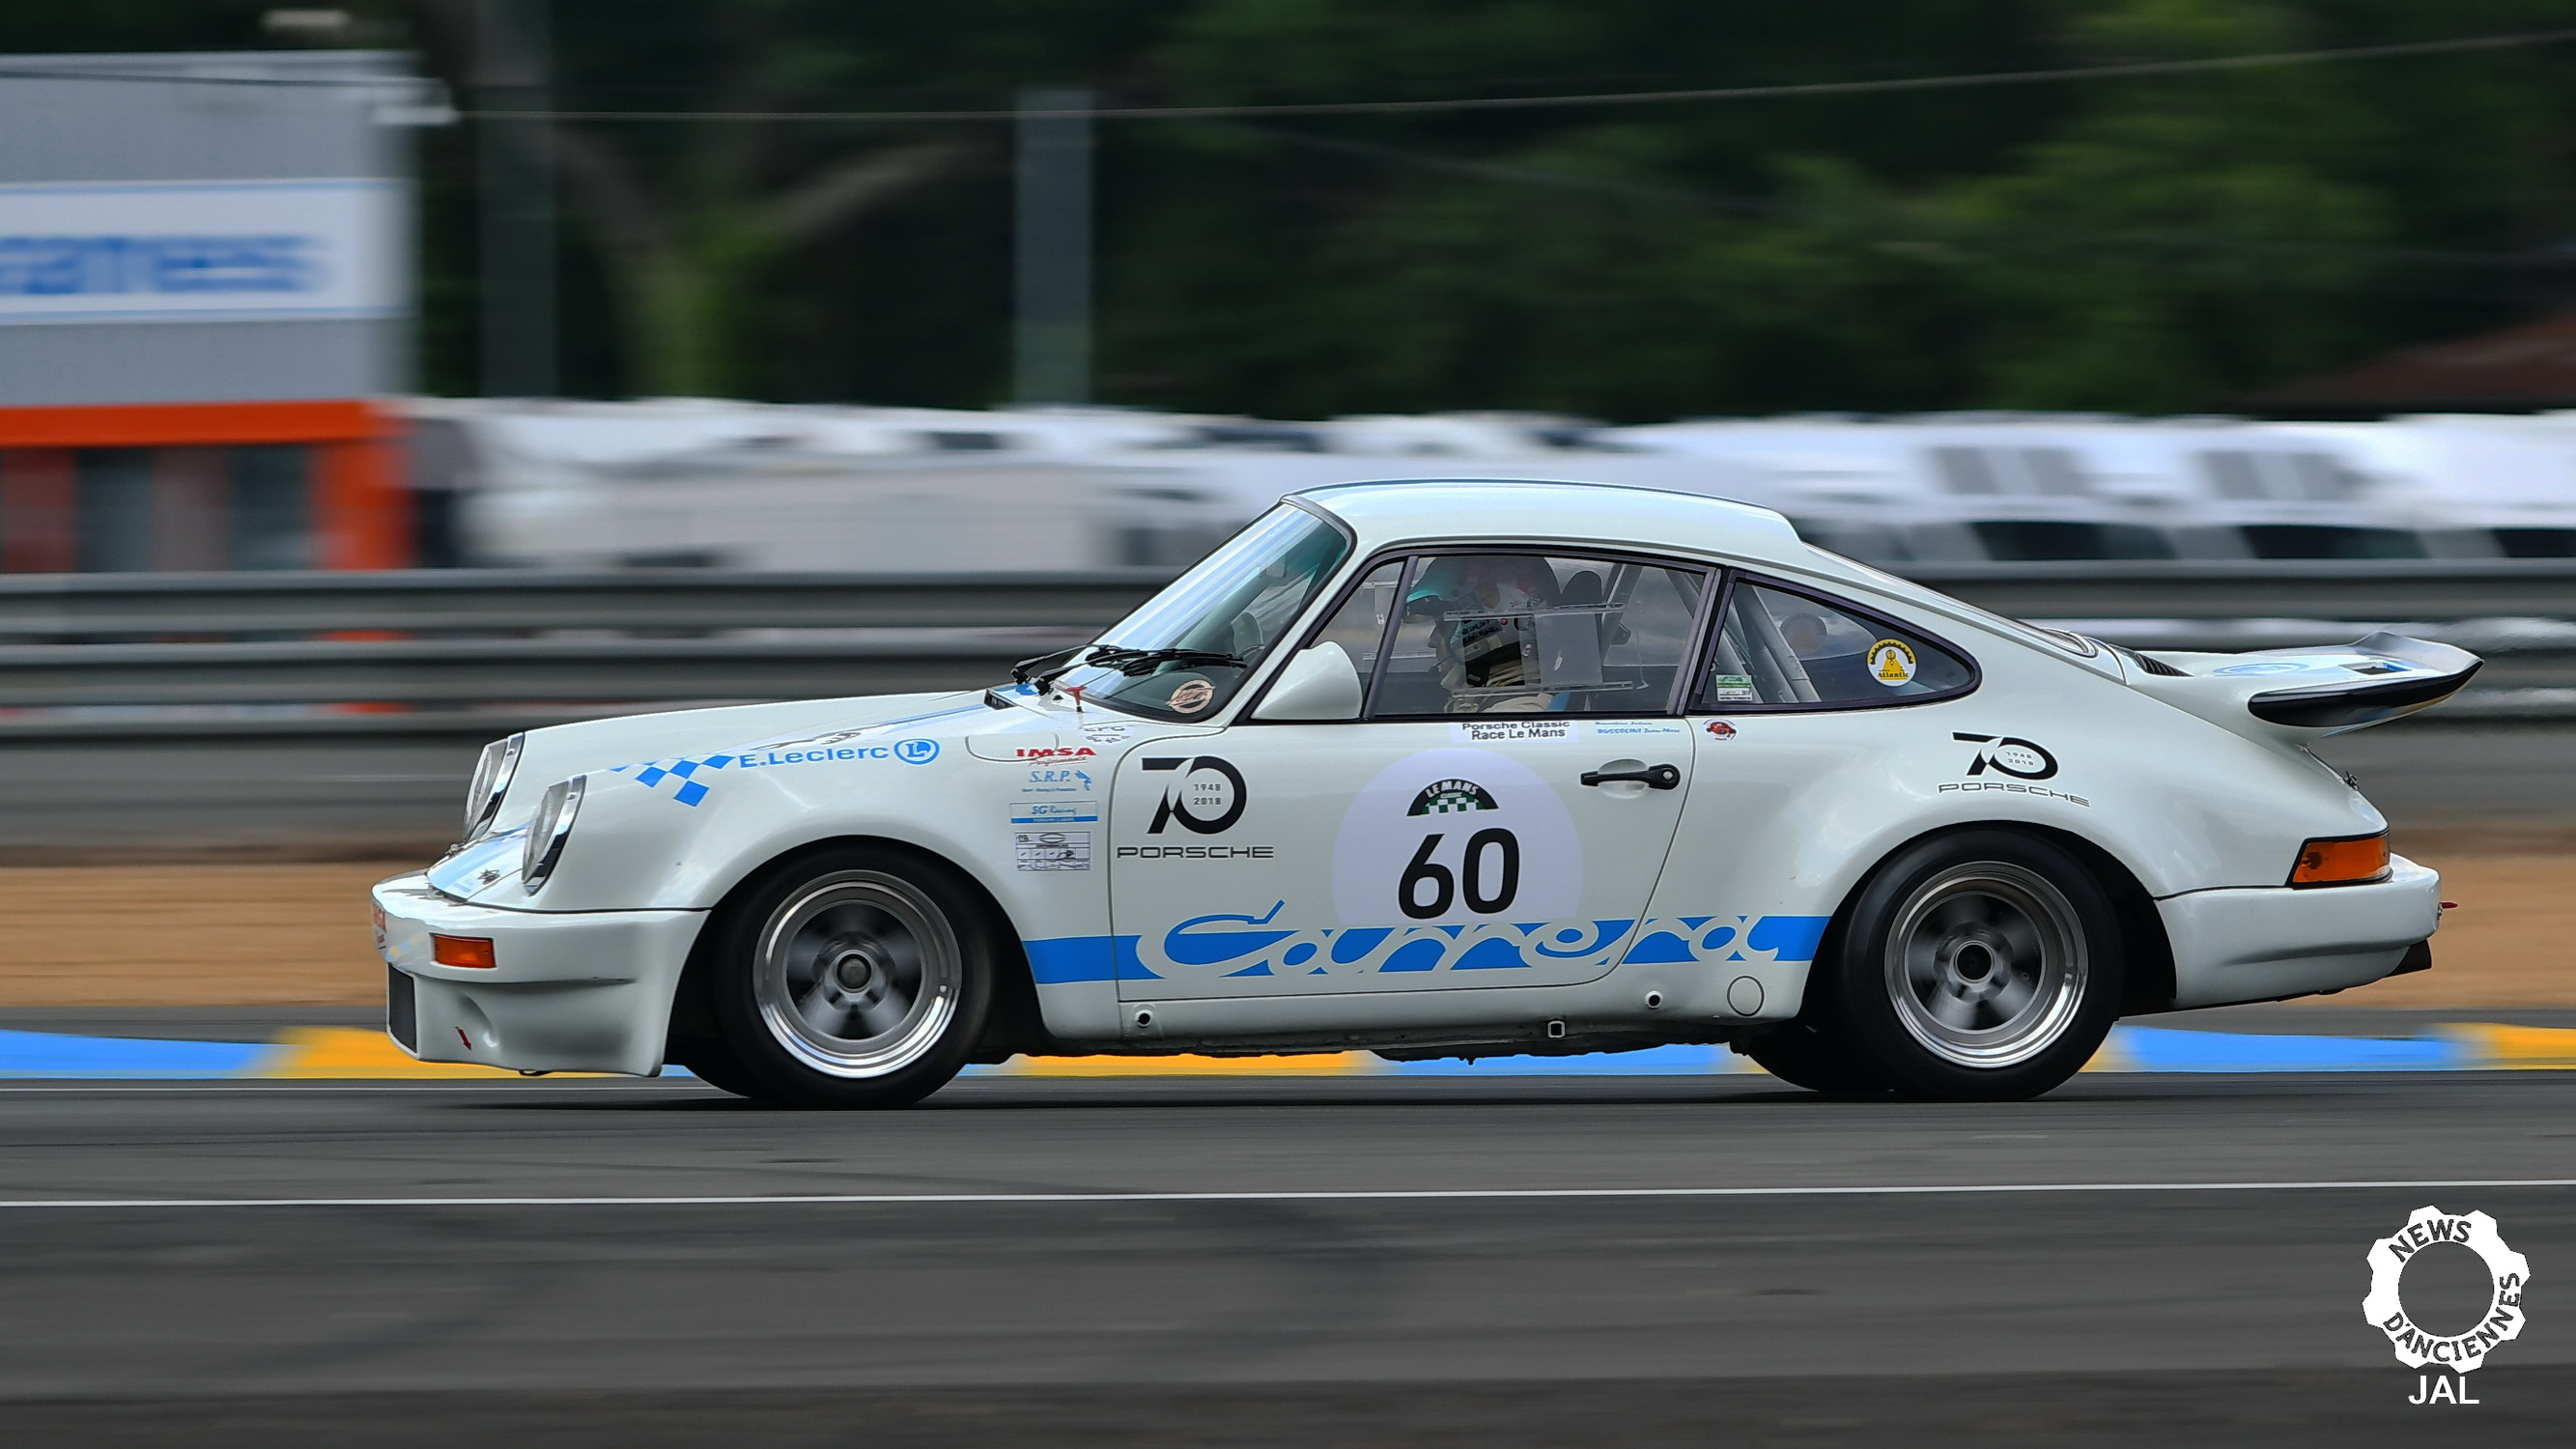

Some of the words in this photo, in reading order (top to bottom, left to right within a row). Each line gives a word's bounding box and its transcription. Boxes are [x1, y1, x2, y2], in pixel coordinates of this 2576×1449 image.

[1461, 723, 1518, 731] Porsche
[1520, 721, 1571, 729] Classic
[1471, 729, 1506, 741] Race
[1508, 728, 1525, 739] Le
[1528, 727, 1567, 738] Mans
[740, 746, 890, 769] E.Leclerc
[1016, 748, 1097, 757] IMSA
[1951, 731, 2059, 781] 70
[2007, 757, 2035, 767] 2018
[1029, 770, 1071, 783] S.R.P.
[1193, 782, 1223, 792] 1948
[1425, 783, 1440, 799] LE
[1440, 781, 1480, 796] MANS
[1141, 754, 1248, 836] 70
[1193, 797, 1223, 806] 2018
[1938, 782, 2091, 808] PORSCHE
[1117, 846, 1275, 859] PORSCHE
[1398, 827, 1520, 920] 60
[1136, 899, 1779, 978] Carrera
